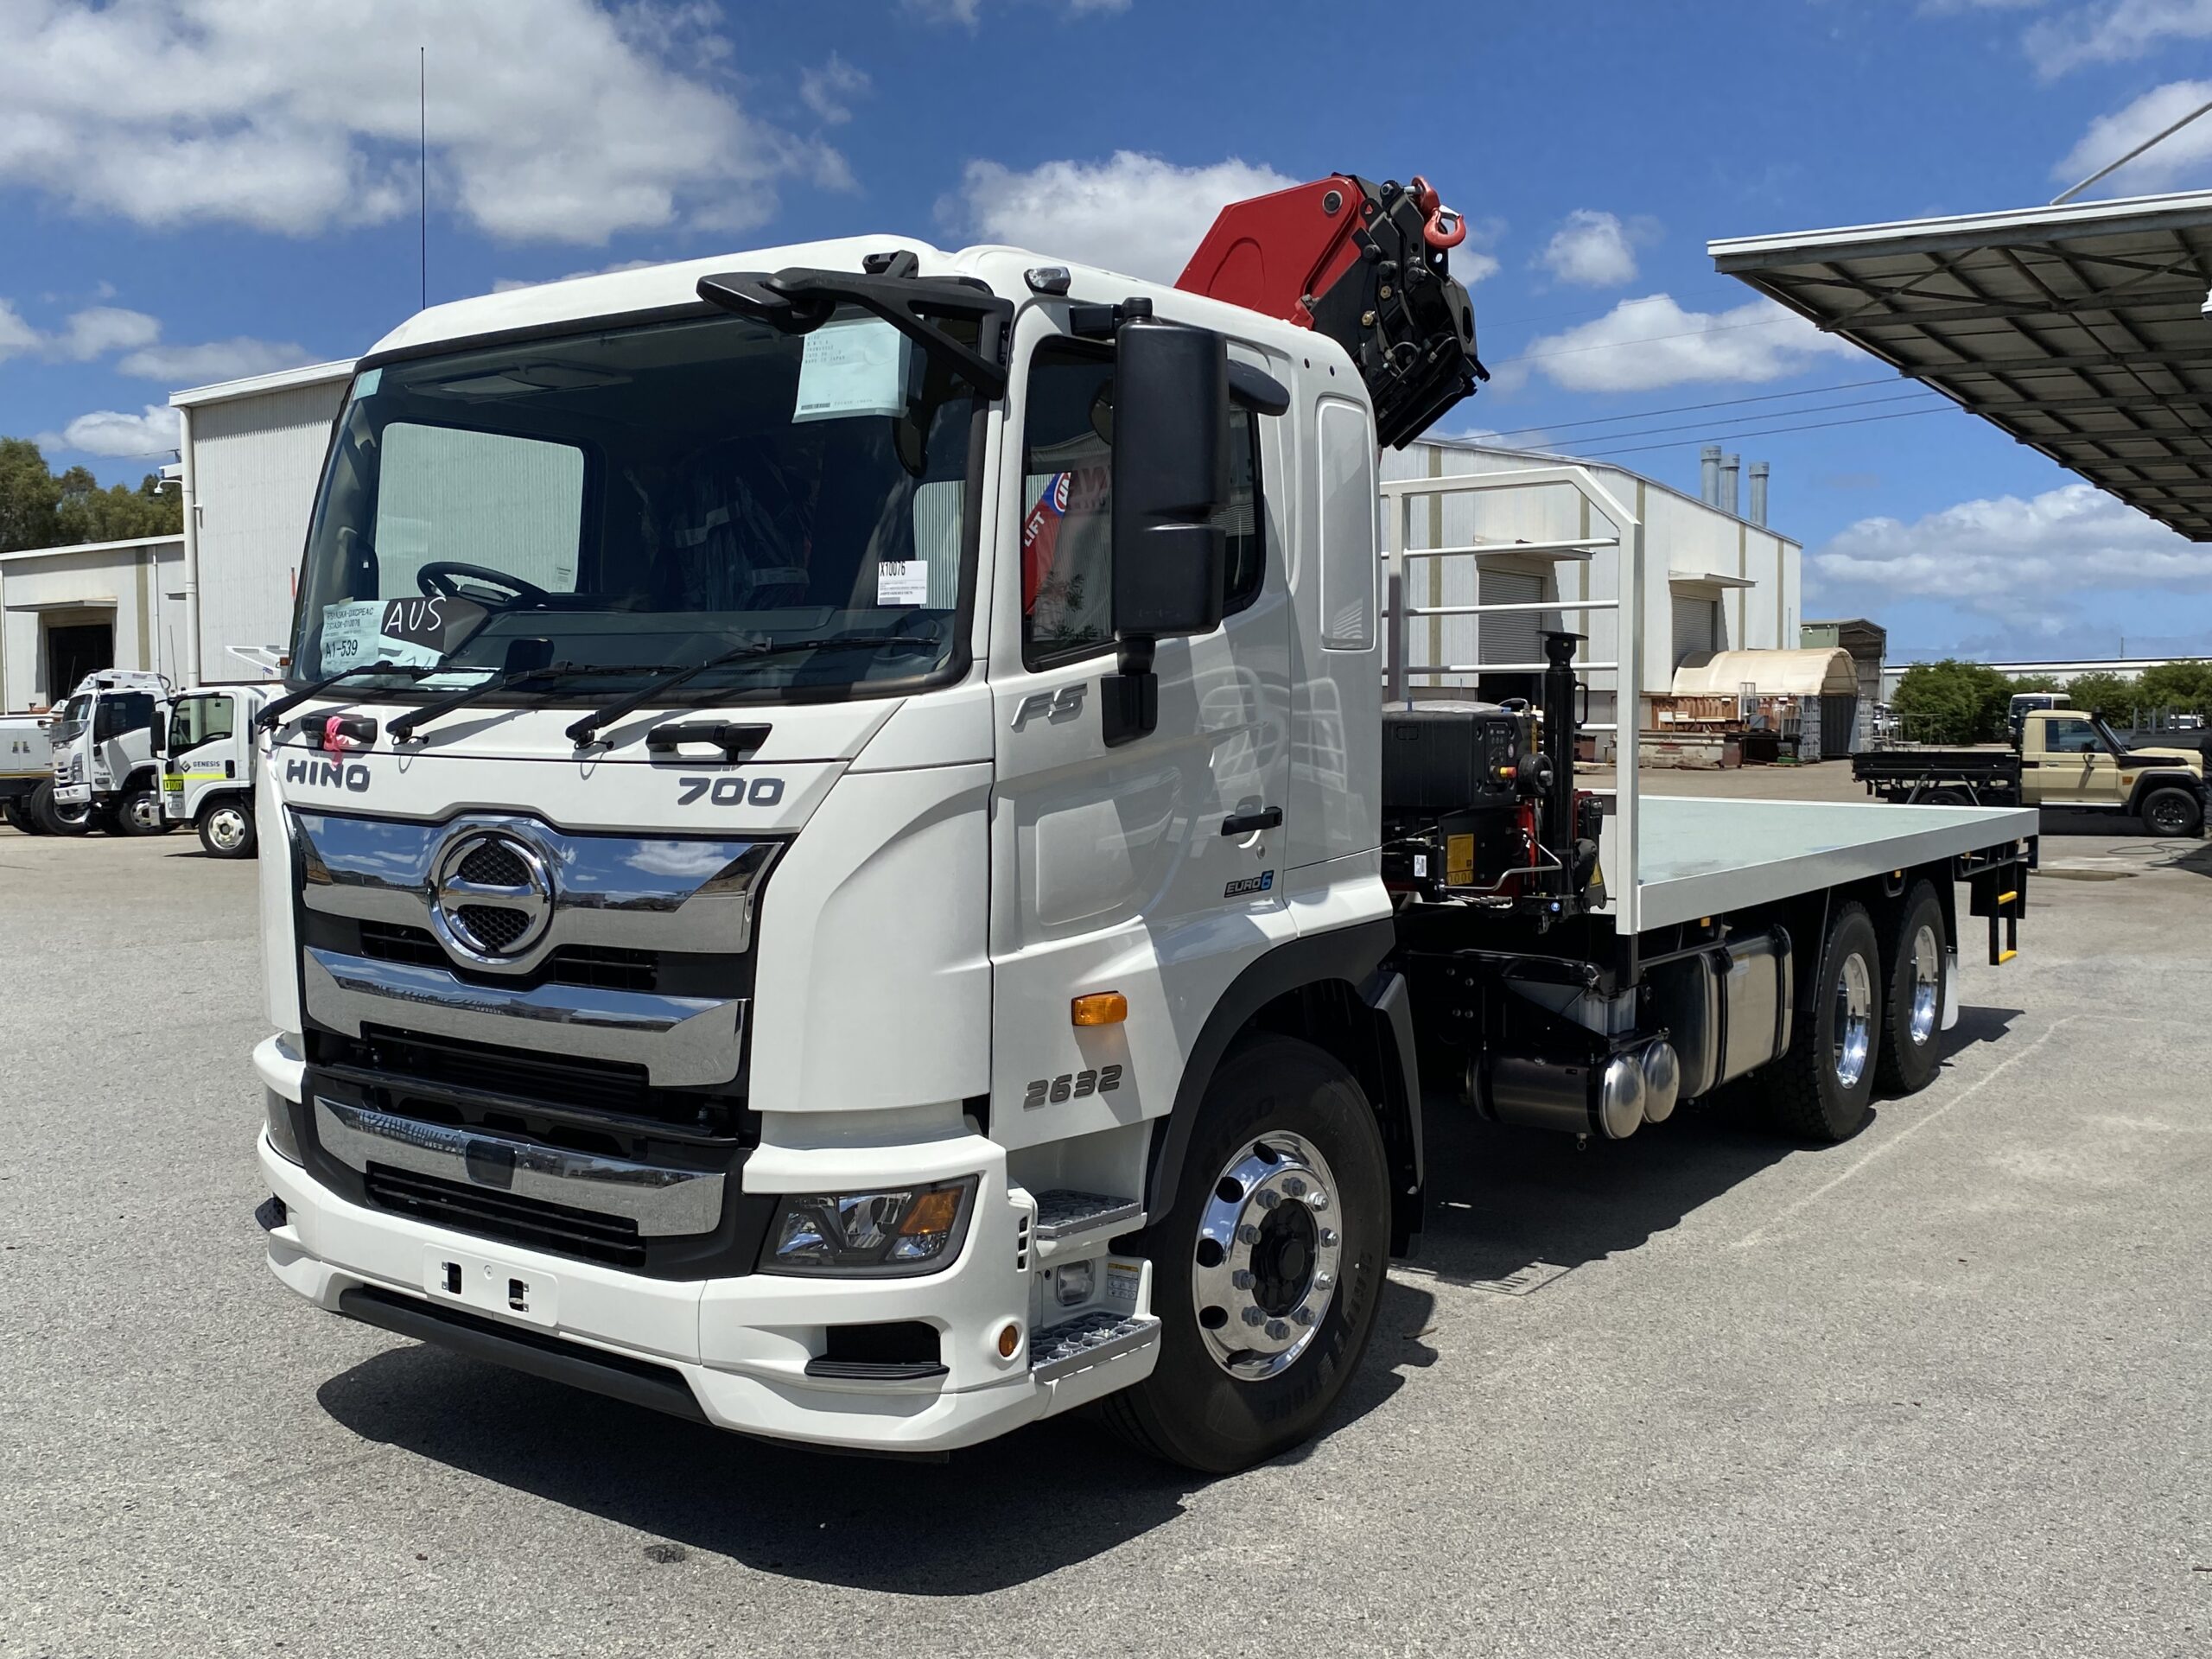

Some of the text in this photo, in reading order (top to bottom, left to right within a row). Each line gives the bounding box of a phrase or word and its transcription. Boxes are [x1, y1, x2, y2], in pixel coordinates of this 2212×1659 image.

[384, 596, 447, 632] AUS
[325, 639, 358, 658] A1-539
[286, 759, 371, 793] HINO
[677, 777, 785, 807] 700
[1023, 1064, 1122, 1111] 2632
